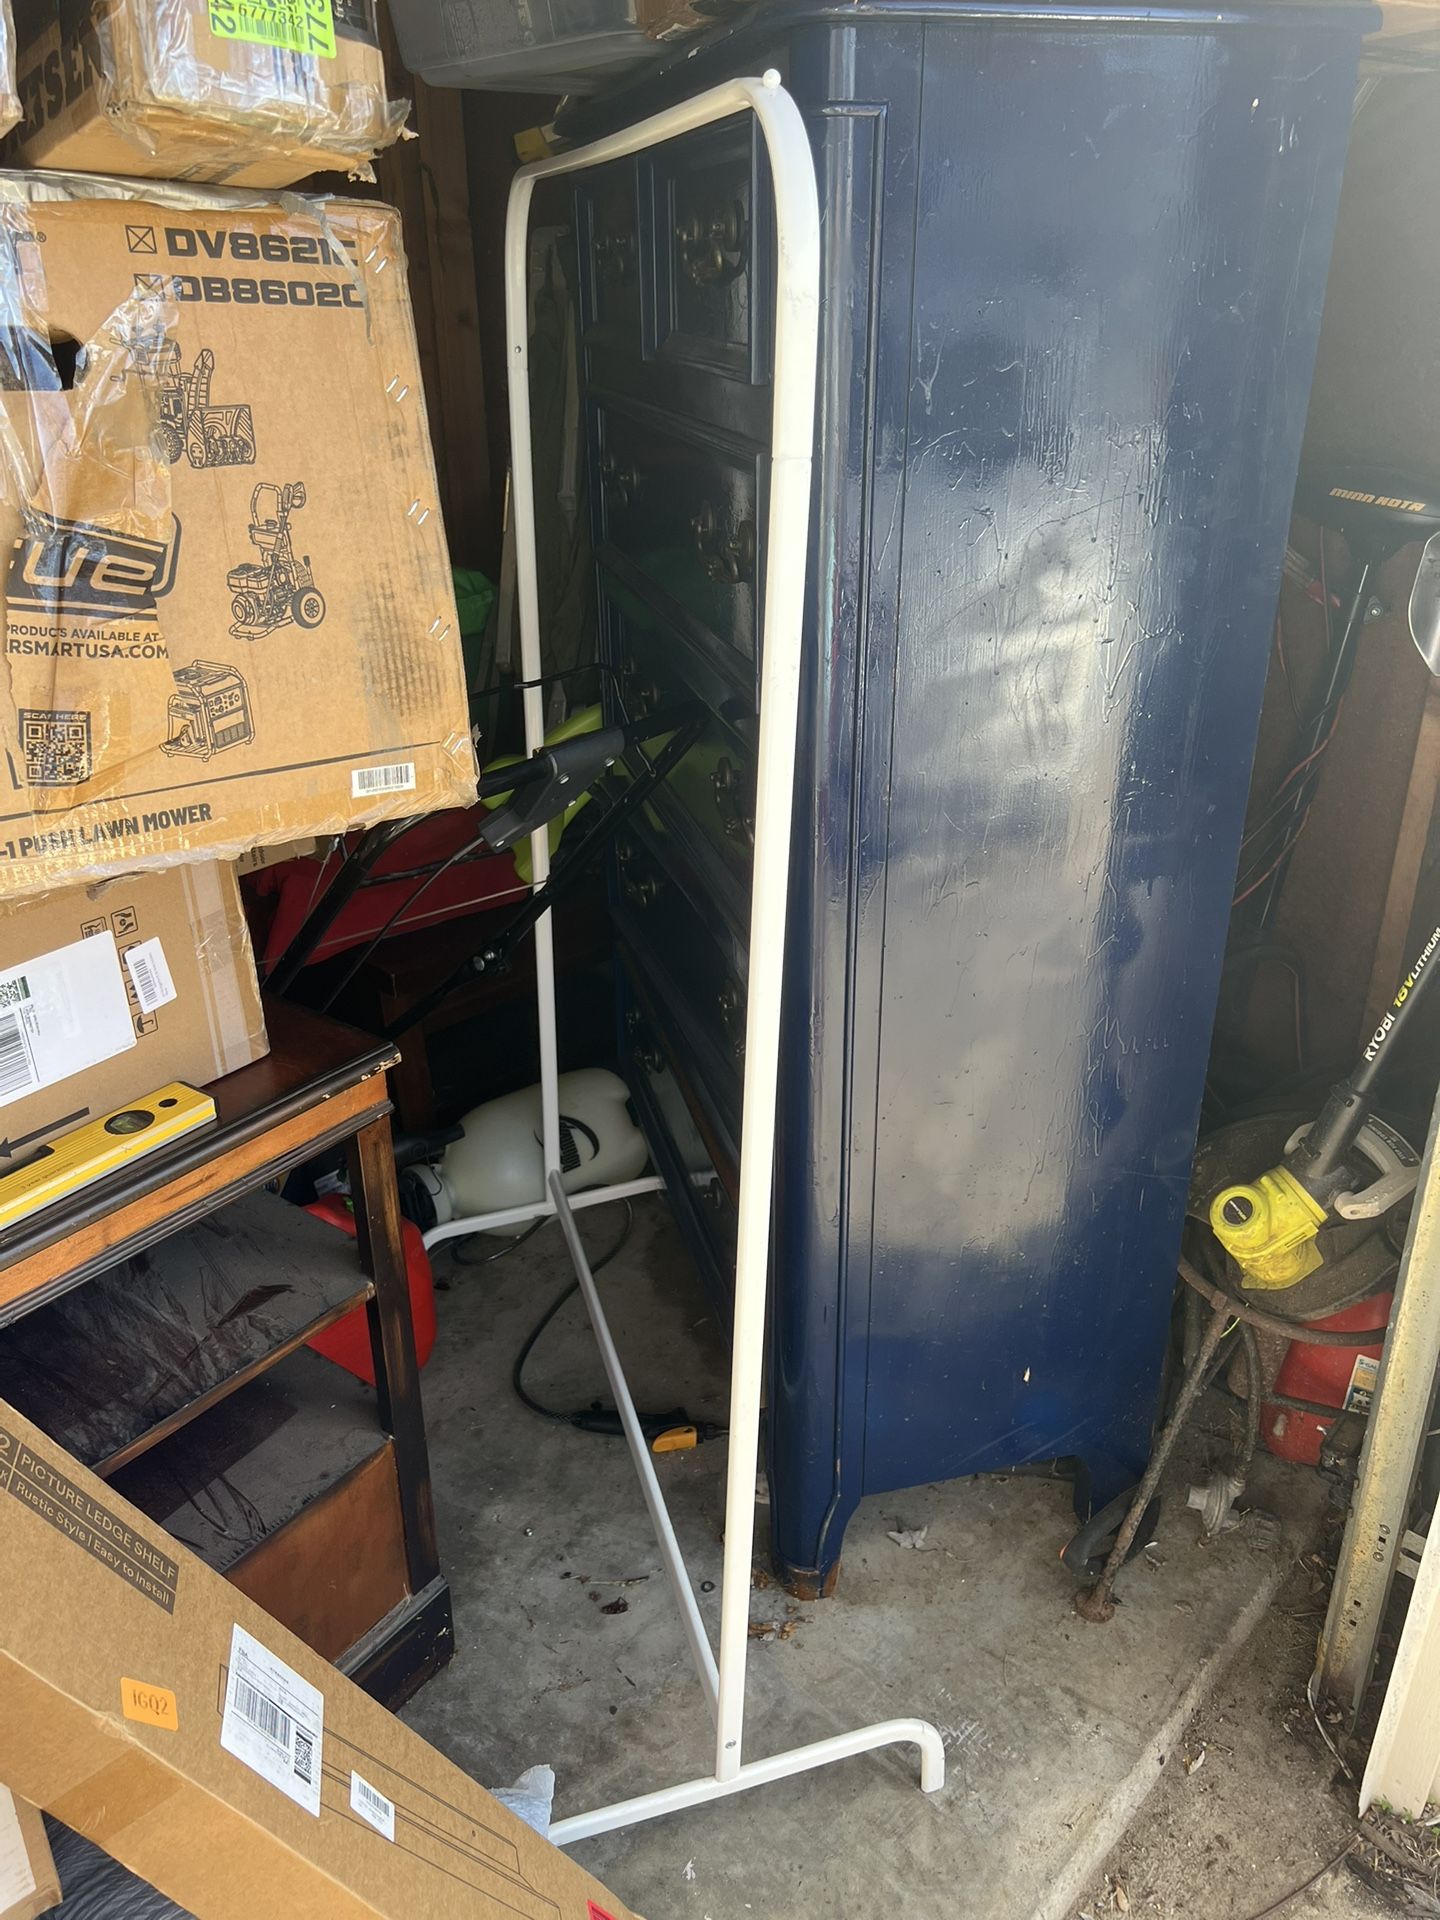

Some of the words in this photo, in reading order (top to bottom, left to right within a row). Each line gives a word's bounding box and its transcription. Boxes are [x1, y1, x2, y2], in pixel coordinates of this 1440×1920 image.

[238, 3, 304, 29] 6777342
[4, 638, 170, 659] RSMARTUSA.COM
[71, 628, 141, 642] AVAILABLE
[143, 632, 160, 642] AT
[18, 827, 74, 857] PUSH
[79, 815, 140, 847] LAWN
[142, 802, 213, 832] MOWER
[1363, 1012, 1396, 1062] RYOBI
[20, 1453, 85, 1511] PICTURE
[85, 1502, 133, 1548] LEDGE
[134, 1541, 176, 1580] SHELF
[16, 1481, 54, 1517] Rustic
[55, 1511, 86, 1543] Style
[93, 1542, 121, 1569] Easy
[122, 1562, 134, 1578] to
[135, 1571, 169, 1605] Install
